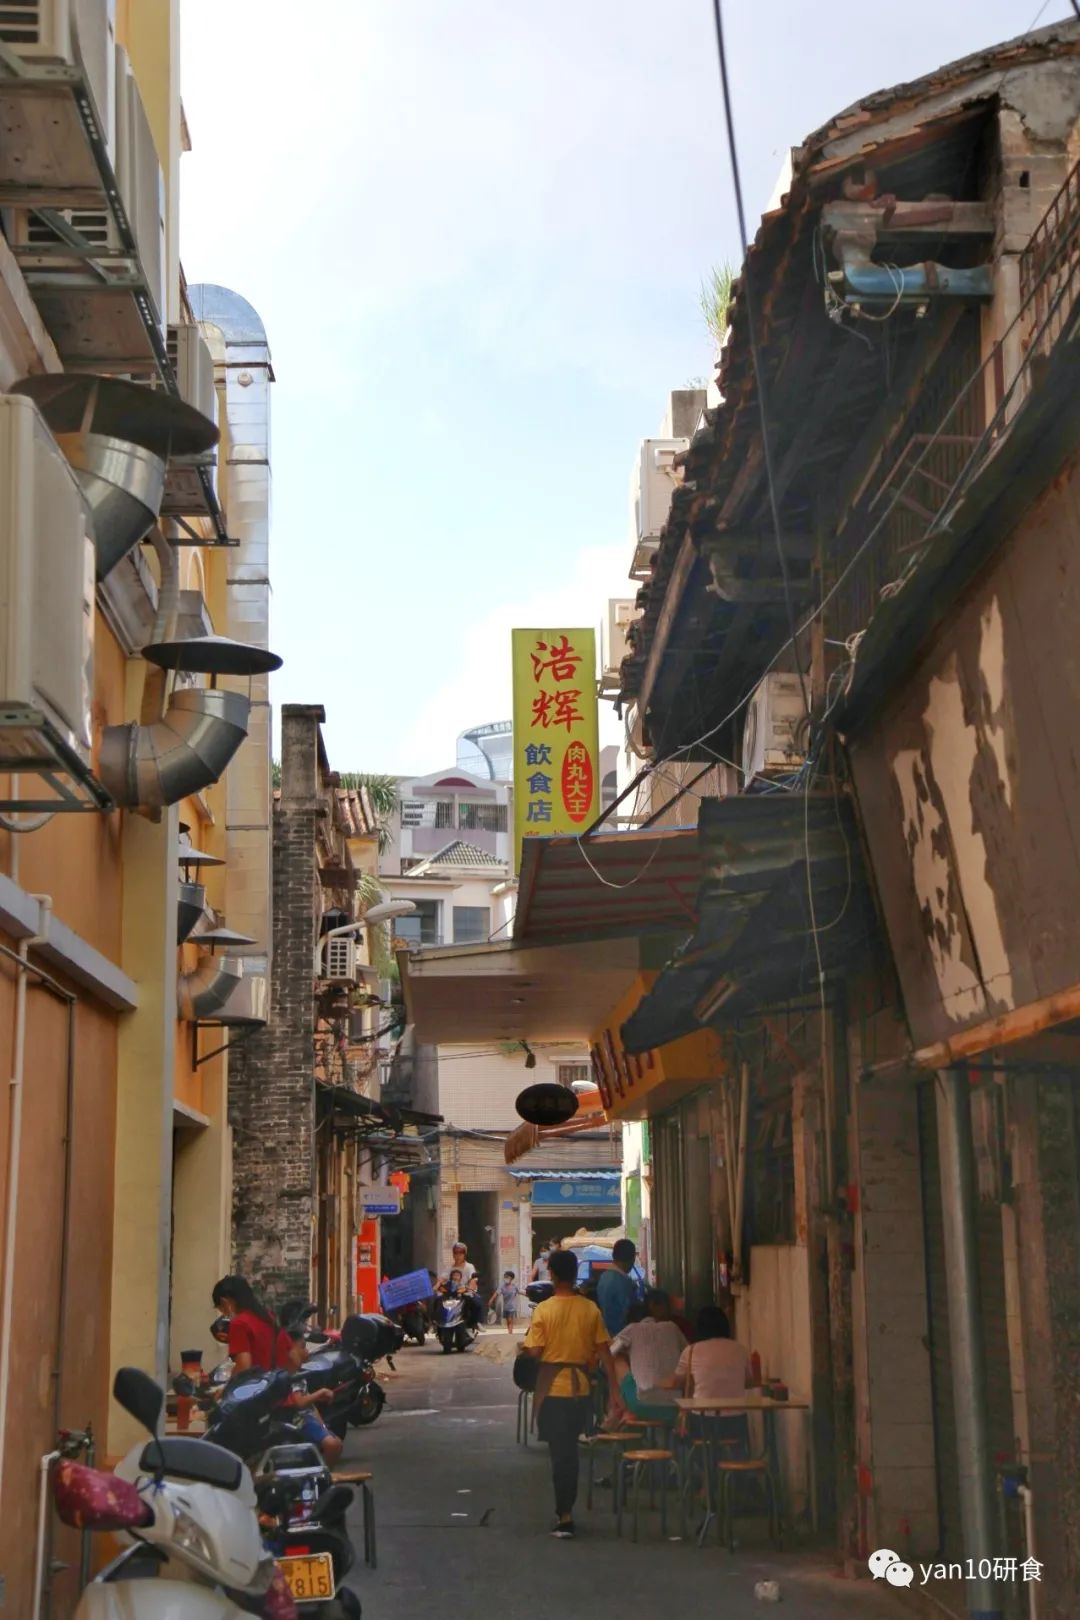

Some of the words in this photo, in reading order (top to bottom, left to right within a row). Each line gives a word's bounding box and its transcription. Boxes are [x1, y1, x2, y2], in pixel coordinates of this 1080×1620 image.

[524, 743, 552, 822] 飲食店
[565, 747, 588, 815] 肉丸大王
